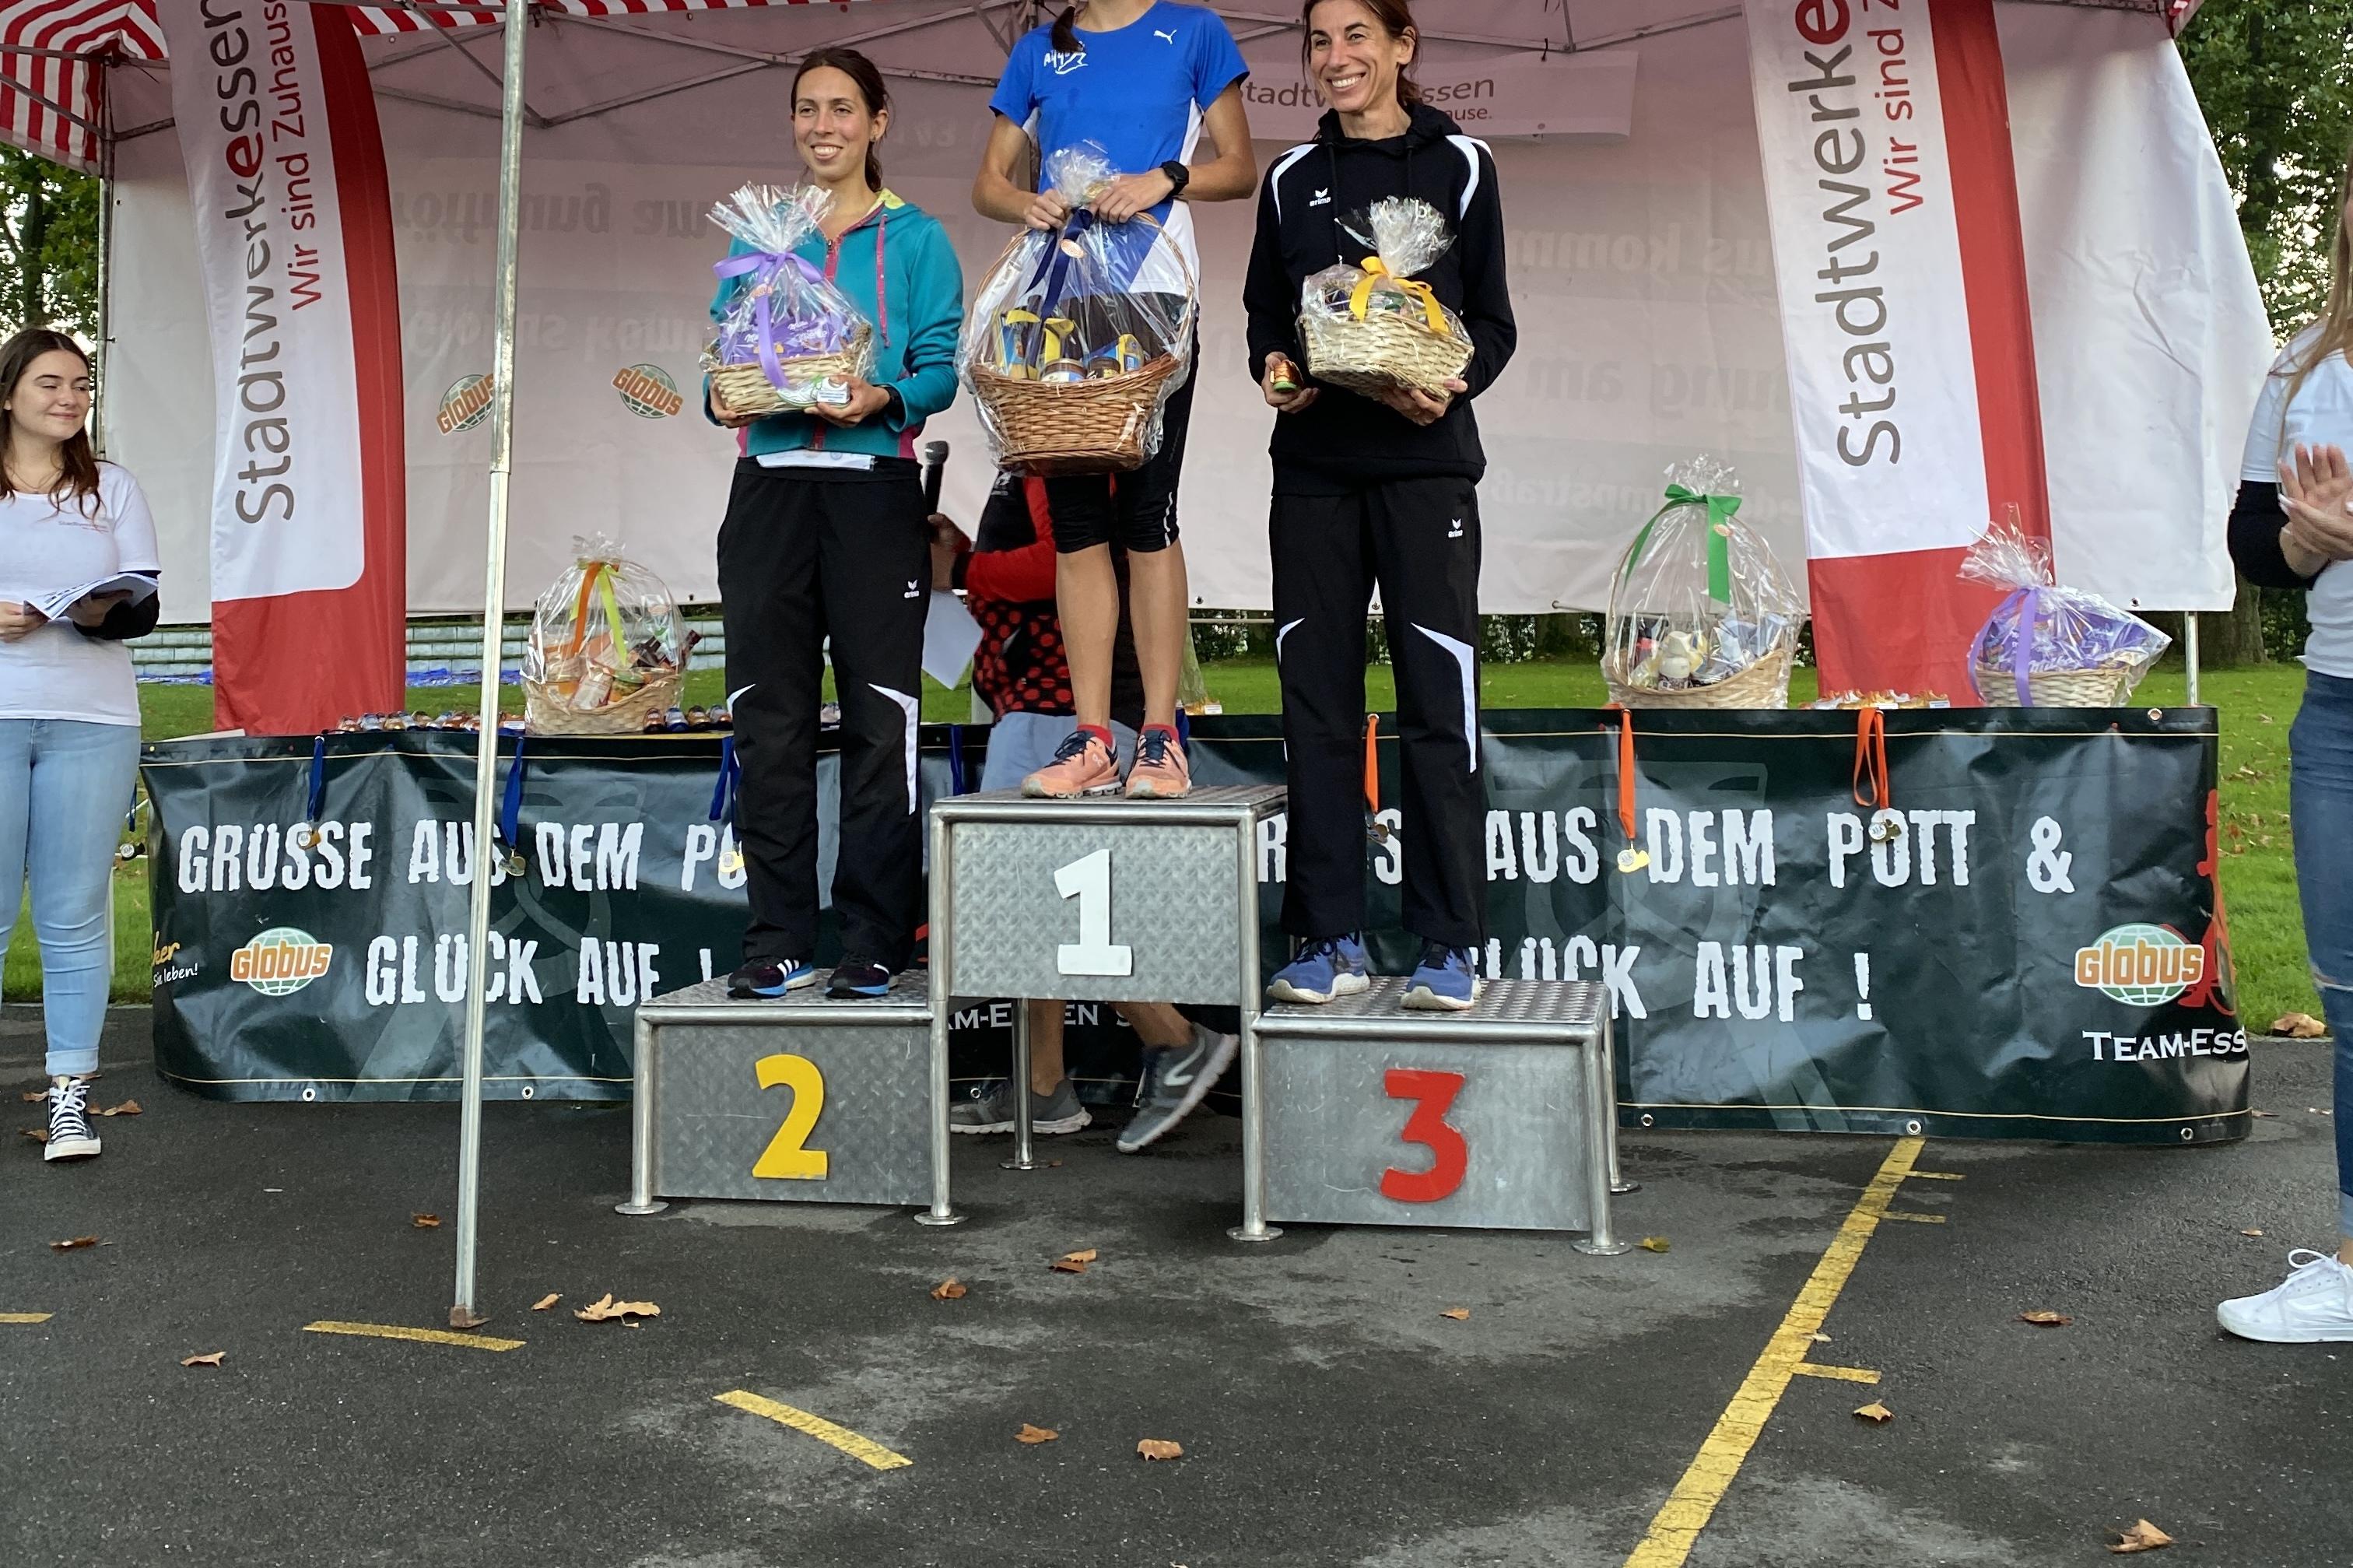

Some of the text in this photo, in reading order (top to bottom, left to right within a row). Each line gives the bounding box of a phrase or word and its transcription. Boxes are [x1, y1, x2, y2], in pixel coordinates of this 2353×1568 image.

[1868, 28, 1914, 121] sind
[263, 0, 322, 311] Wir sind Zuhaus
[1882, 138, 1924, 216] Wir
[612, 367, 683, 416] Globus
[178, 820, 373, 893] GRÜSSE
[534, 821, 644, 892] DEM
[681, 821, 748, 892] PO
[1485, 807, 1600, 885] AUS
[1645, 808, 1776, 887] DEM
[1826, 807, 1976, 889] POTT
[2025, 815, 2075, 894] &
[1053, 848, 1132, 977] 1
[233, 939, 331, 980] Globus
[365, 933, 544, 1005] GLÜCK
[577, 936, 661, 1006] AUF
[1693, 941, 1804, 1022] AUF
[1853, 952, 1874, 1022] !
[2077, 938, 2204, 985] Globus
[751, 1054, 829, 1181] 2
[1380, 1068, 1468, 1202] 3
